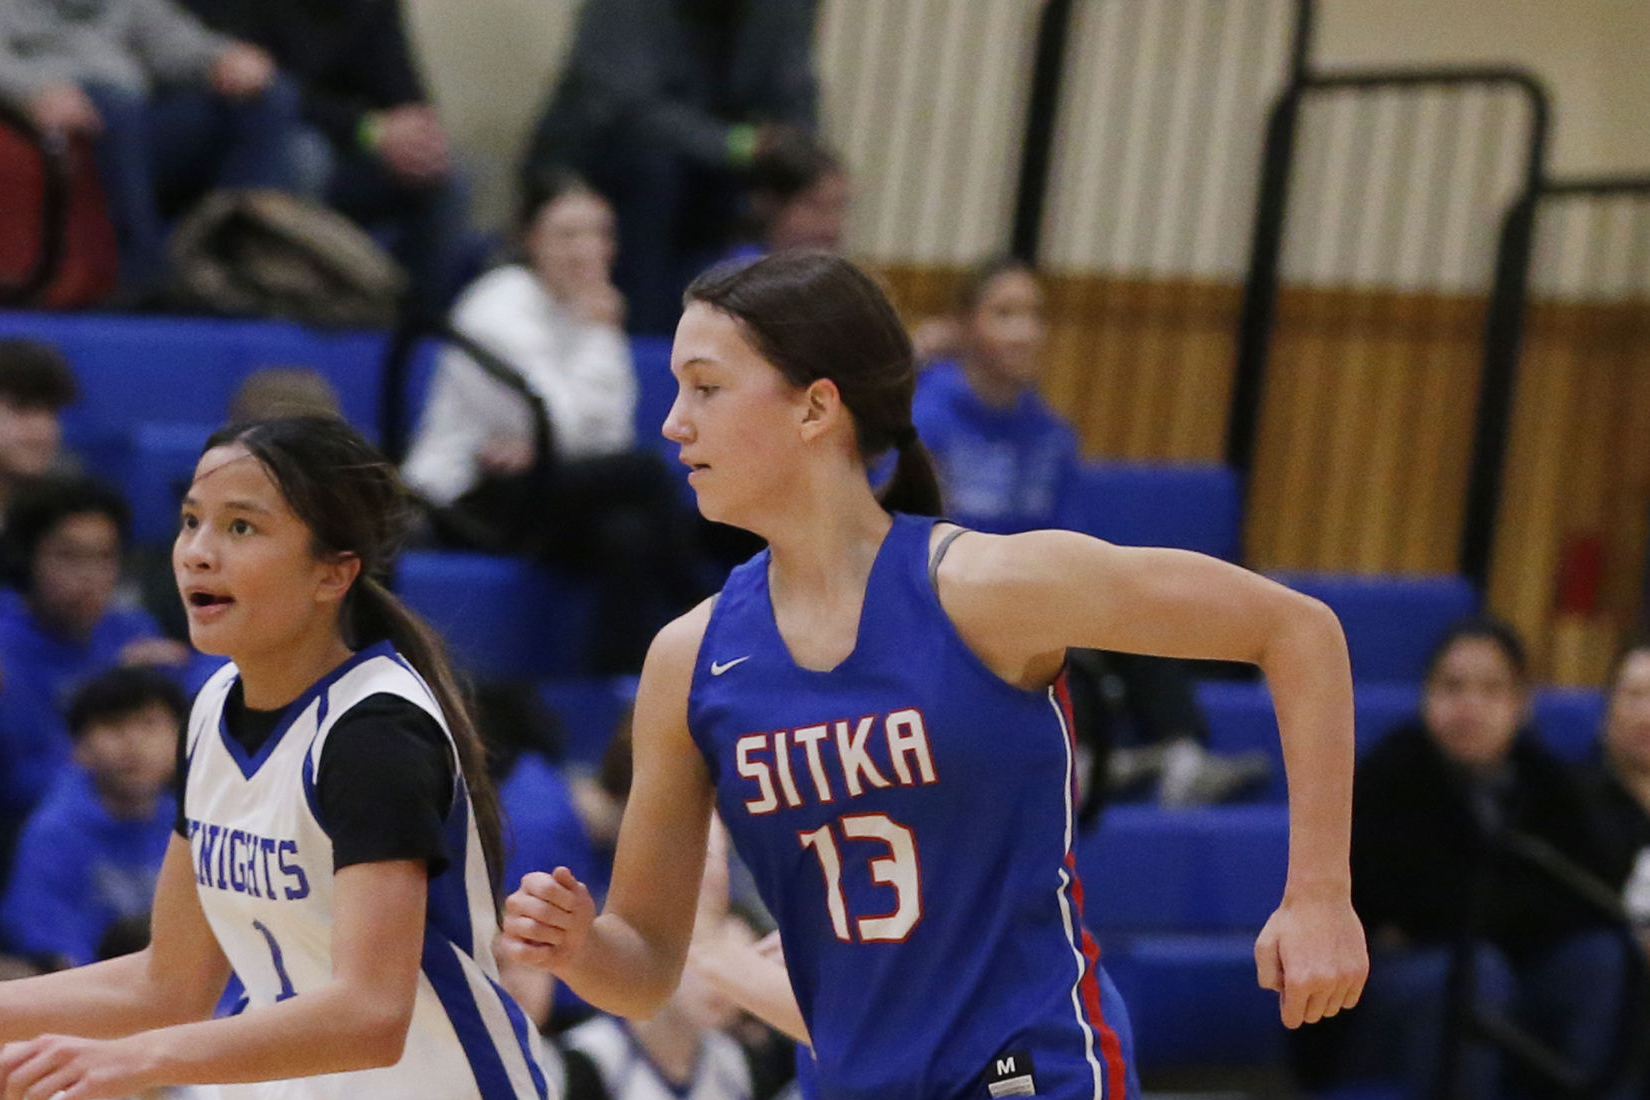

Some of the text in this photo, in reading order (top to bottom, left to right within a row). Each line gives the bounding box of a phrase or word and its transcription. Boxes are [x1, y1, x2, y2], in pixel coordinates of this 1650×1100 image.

[736, 706, 938, 815] SITKA
[798, 811, 924, 943] 13
[252, 919, 299, 1003] 1
[996, 1056, 1016, 1076] M
